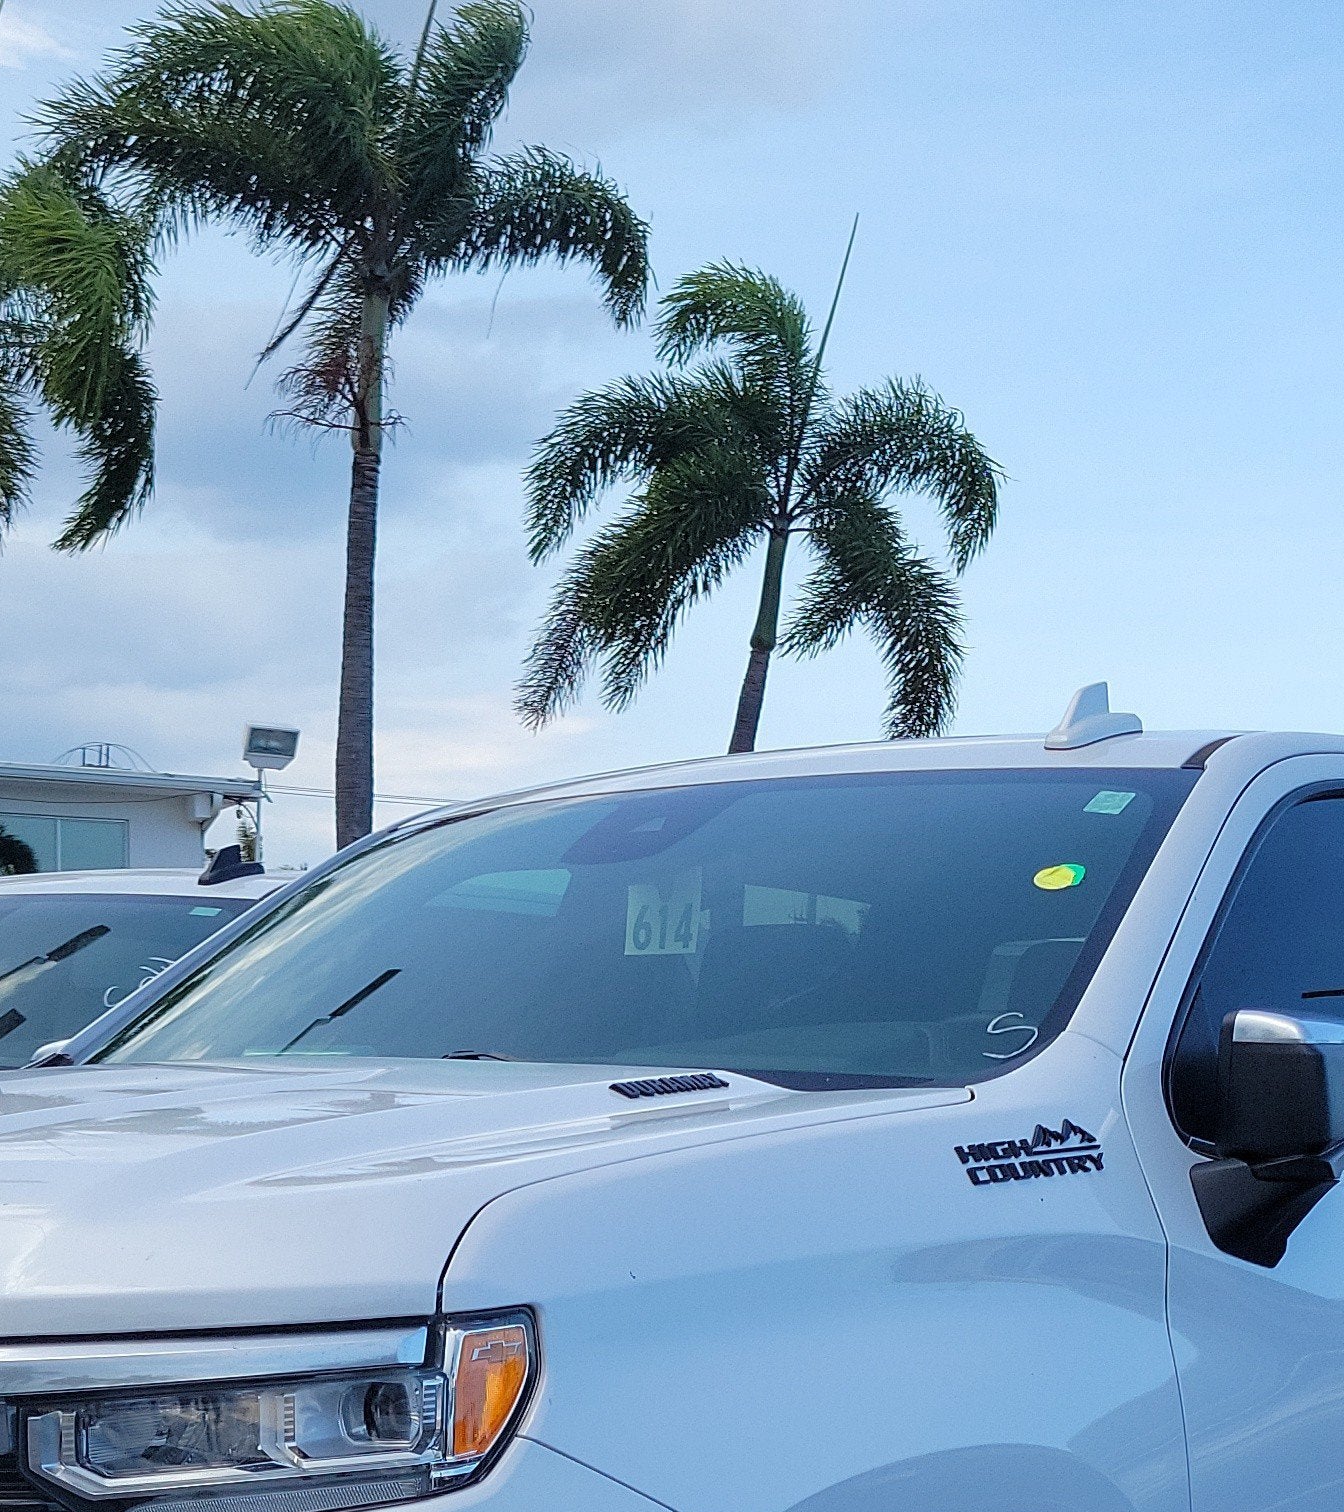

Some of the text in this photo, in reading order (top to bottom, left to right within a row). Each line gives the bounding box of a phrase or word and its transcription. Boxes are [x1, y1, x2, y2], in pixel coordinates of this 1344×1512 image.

[632, 902, 695, 951] 614
[953, 1138, 1034, 1165] HIGH
[966, 1151, 1105, 1187] COUNTRY
